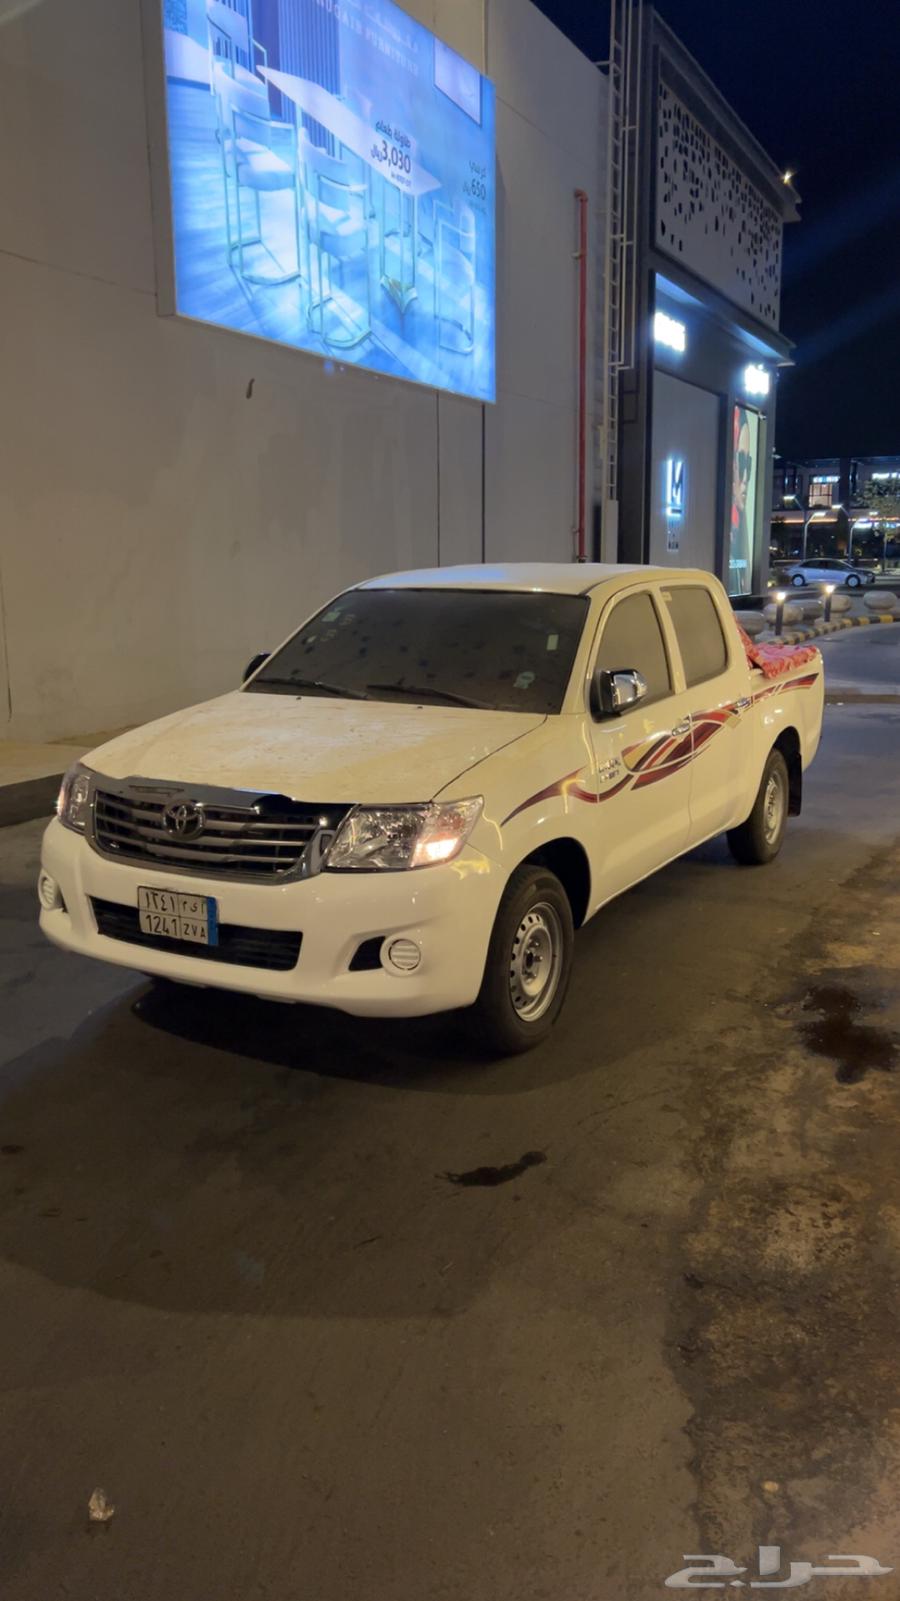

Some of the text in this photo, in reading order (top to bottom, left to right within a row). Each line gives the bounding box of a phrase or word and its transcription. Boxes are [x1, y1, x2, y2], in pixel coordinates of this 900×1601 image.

[382, 139, 411, 174] 3,030
[471, 178, 487, 200] 650
[145, 914, 178, 936] 1241
